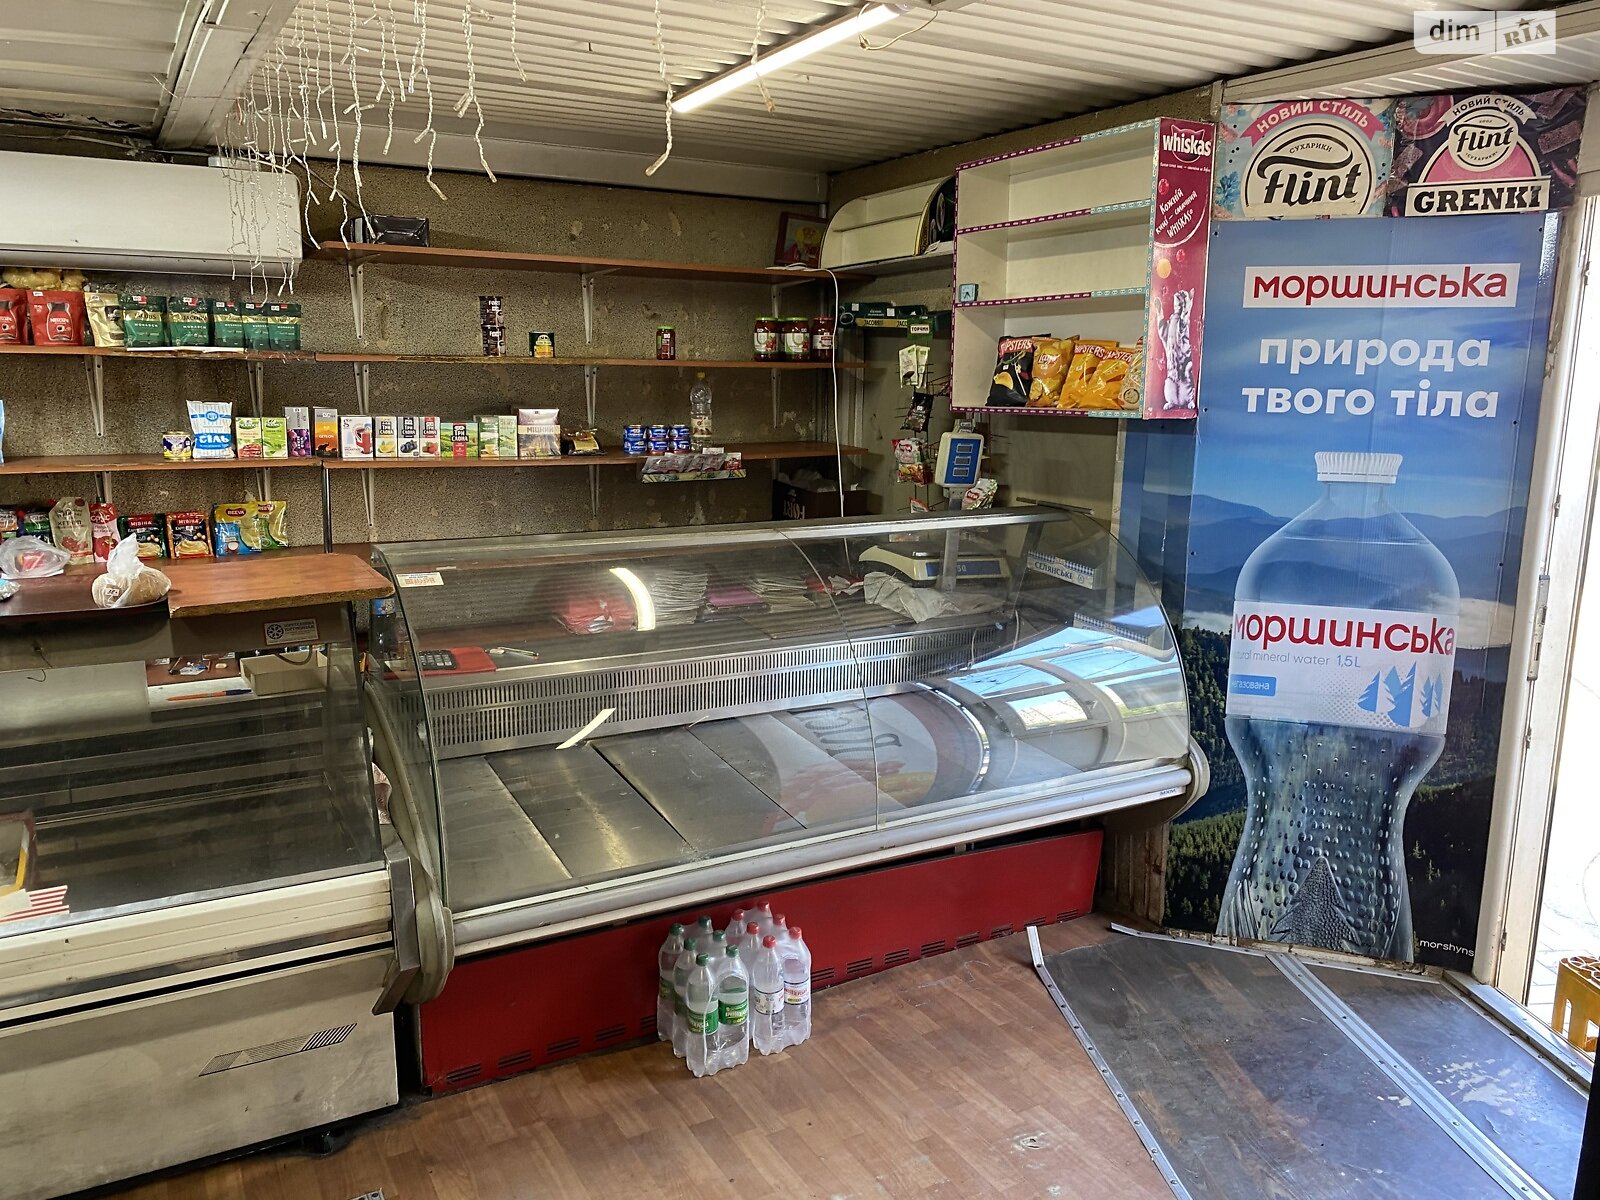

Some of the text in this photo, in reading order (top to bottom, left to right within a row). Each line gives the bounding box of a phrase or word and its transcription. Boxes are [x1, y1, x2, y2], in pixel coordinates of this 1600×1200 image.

[1319, 100, 1368, 128] СТИЛЬ
[1453, 97, 1490, 117] НОВИЙ
[1163, 133, 1212, 157] whiskas
[1289, 143, 1332, 153] СУХАРИКИ
[1414, 186, 1542, 212] GRENKI
[1259, 338, 1490, 375] природа
[1242, 379, 1499, 418] твого тіла
[1034, 561, 1073, 581] СЕЛЯНСЬКЕ
[1253, 651, 1290, 664] mineral
[1293, 655, 1330, 667] water
[1420, 940, 1475, 957] morshyns
